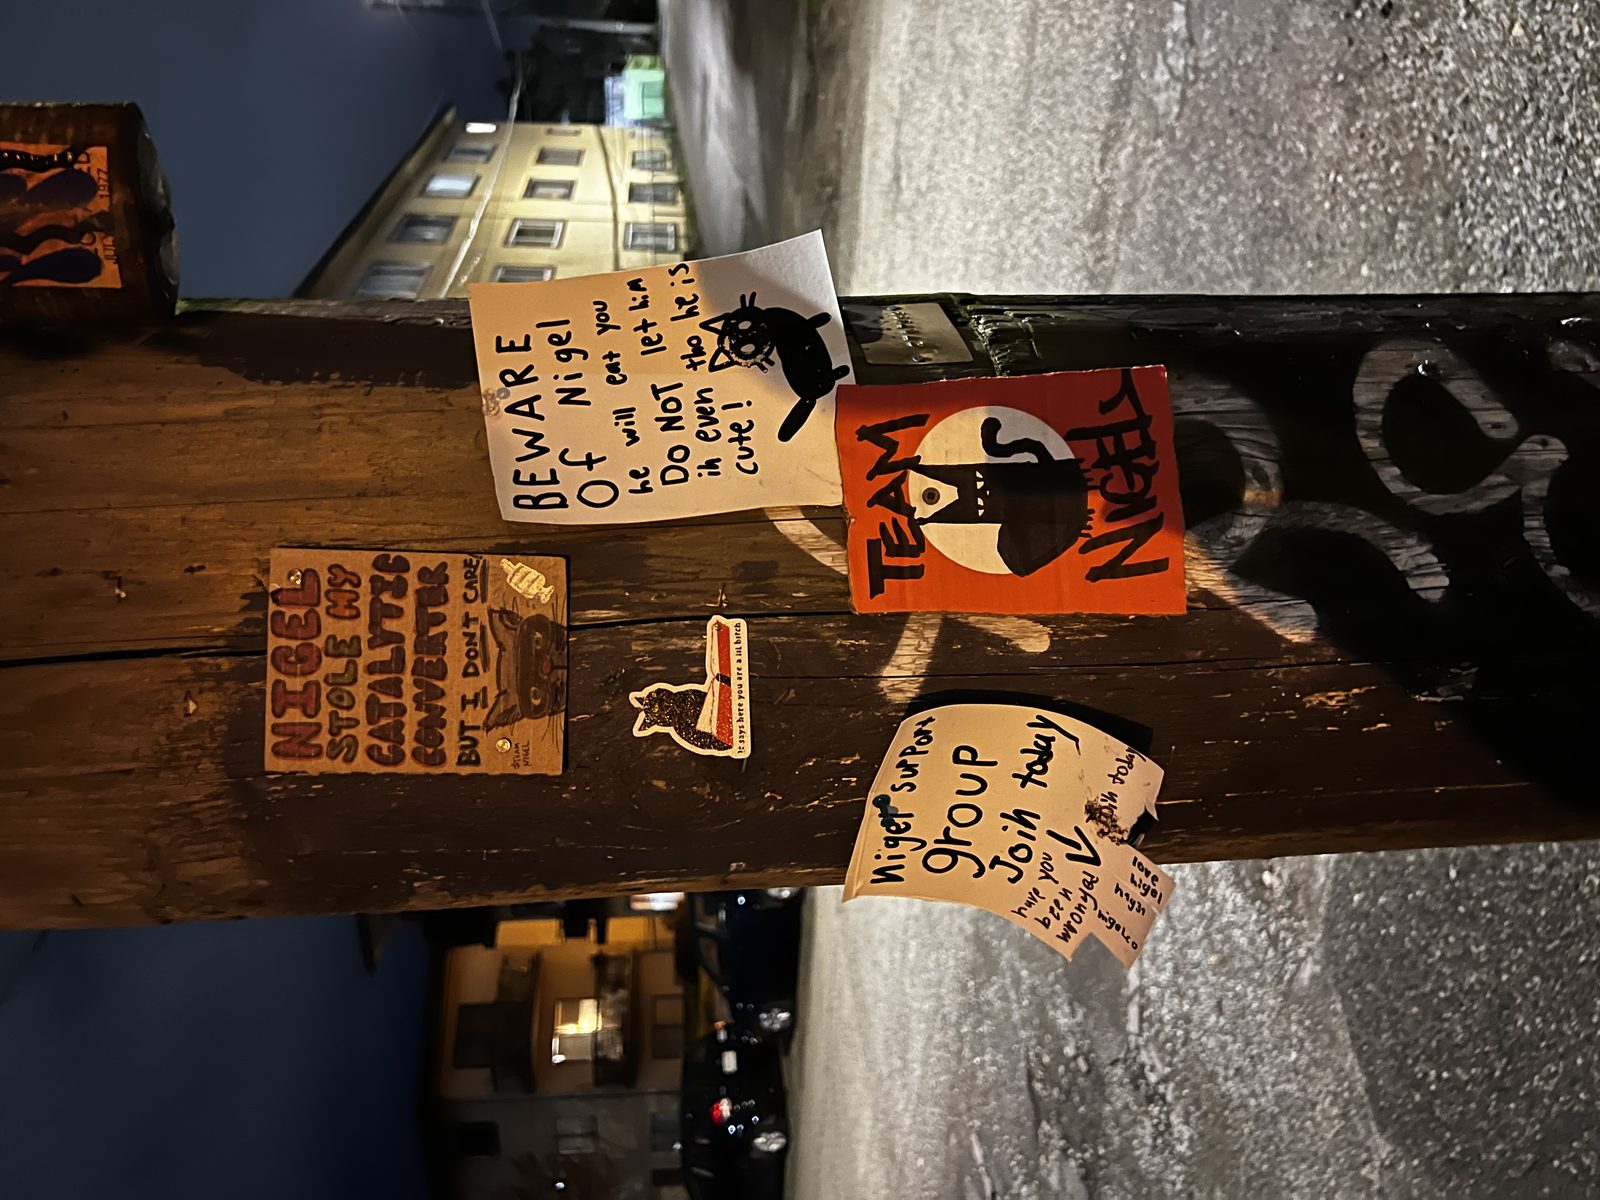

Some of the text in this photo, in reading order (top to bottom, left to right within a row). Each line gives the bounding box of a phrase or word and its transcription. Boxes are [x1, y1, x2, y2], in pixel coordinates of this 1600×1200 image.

[536, 318, 591, 406] Nigel
[639, 319, 667, 356] let
[668, 263, 722, 478] in even tho he is
[495, 333, 568, 510] BEWARE
[593, 300, 653, 494] he will eat you
[855, 414, 929, 598] TEAM
[1063, 369, 1169, 582] NIGEL
[463, 554, 482, 603] CARE!
[269, 567, 323, 760] NIGEL
[323, 563, 361, 764] STOLE MY
[365, 554, 409, 766] CATALYTIC
[412, 561, 447, 766] CONVERTER
[737, 684, 745, 700] you
[461, 691, 480, 709] I
[736, 703, 744, 722] here
[737, 725, 746, 744] says
[457, 721, 480, 766] BUT
[521, 740, 531, 766] NIGEL
[1108, 748, 1146, 784] today
[921, 744, 998, 878] group
[988, 714, 1081, 884] Join today
[1011, 852, 1059, 918] have you
[1131, 856, 1159, 883] love
[1034, 888, 1072, 929] been
[1056, 871, 1099, 943] wronged
